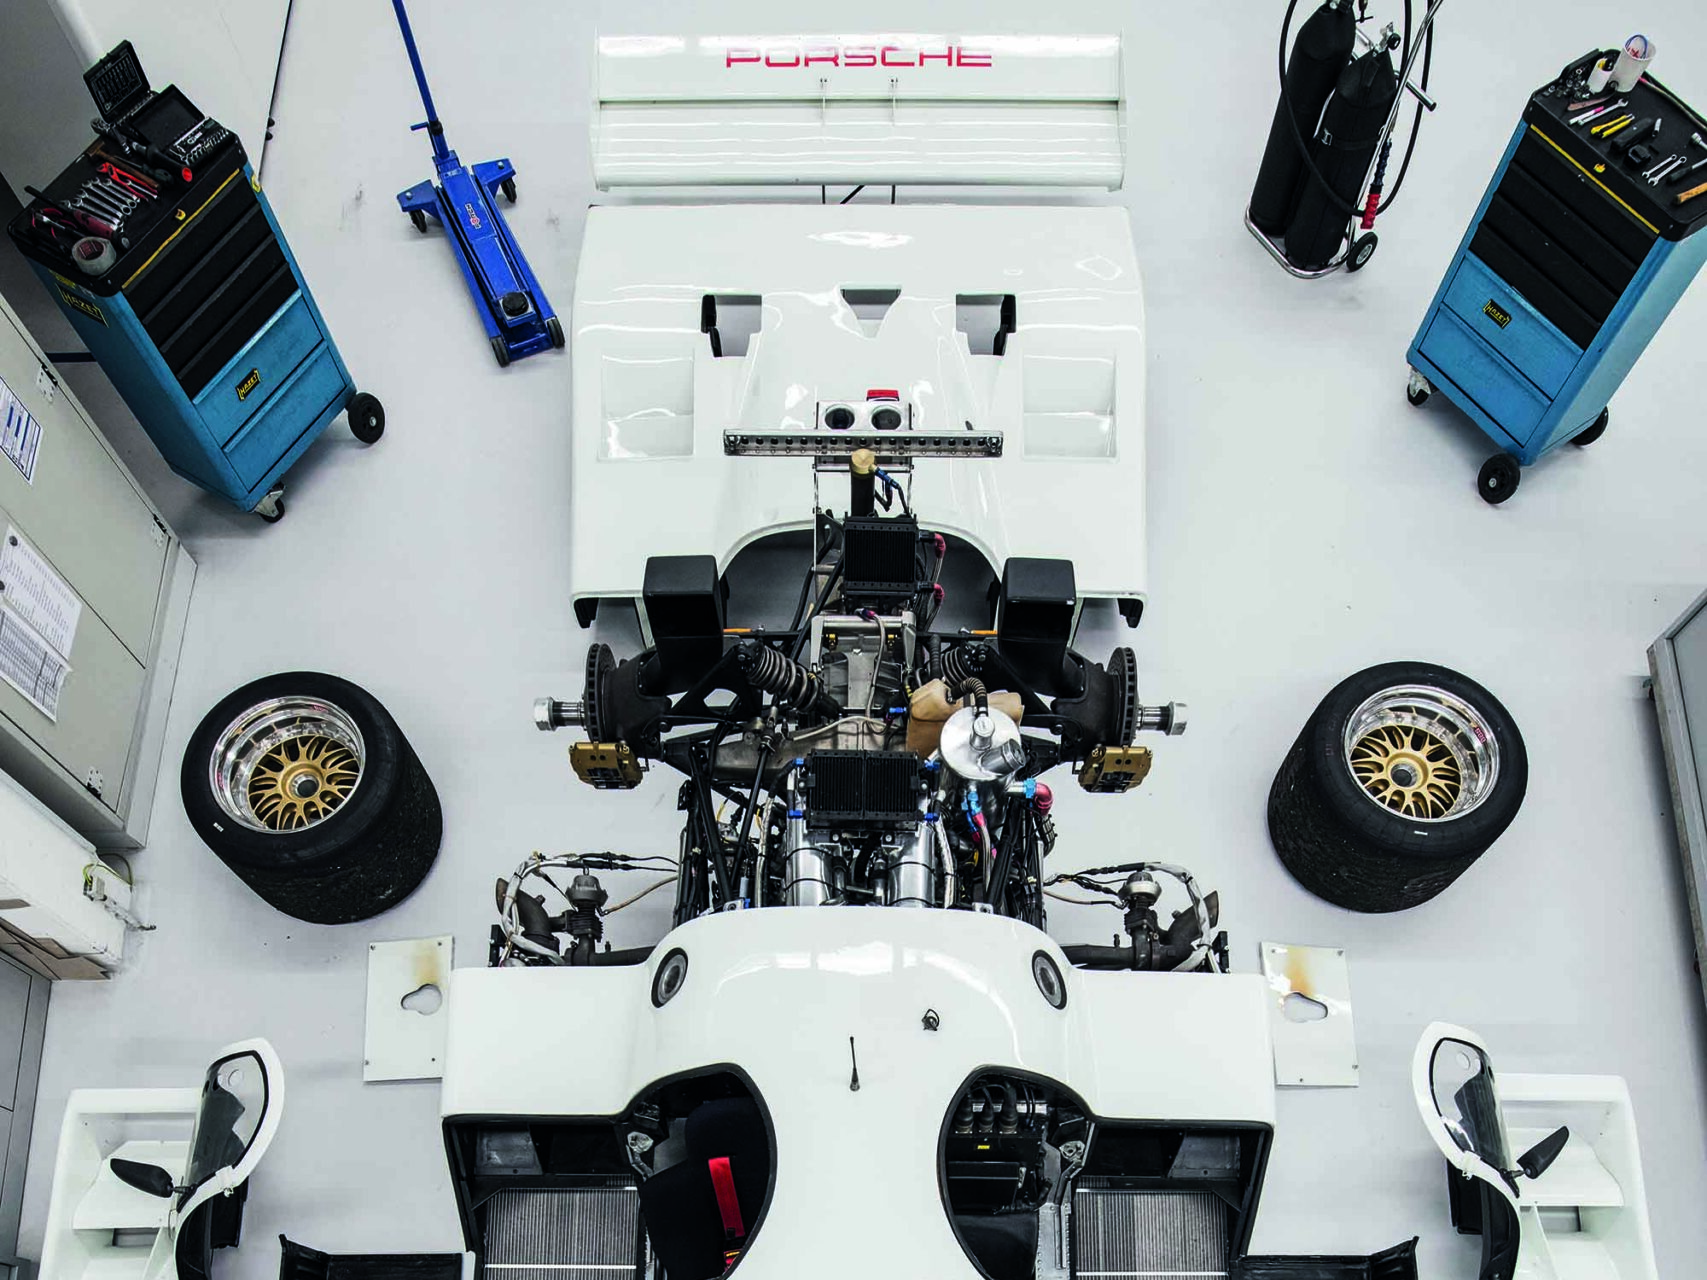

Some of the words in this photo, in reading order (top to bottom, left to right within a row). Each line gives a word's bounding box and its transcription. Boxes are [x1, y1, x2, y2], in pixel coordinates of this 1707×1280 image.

[726, 46, 992, 68] PORSCHE
[61, 289, 99, 316] HAZET
[1485, 303, 1507, 322] HAZET
[239, 373, 258, 397] HAZET
